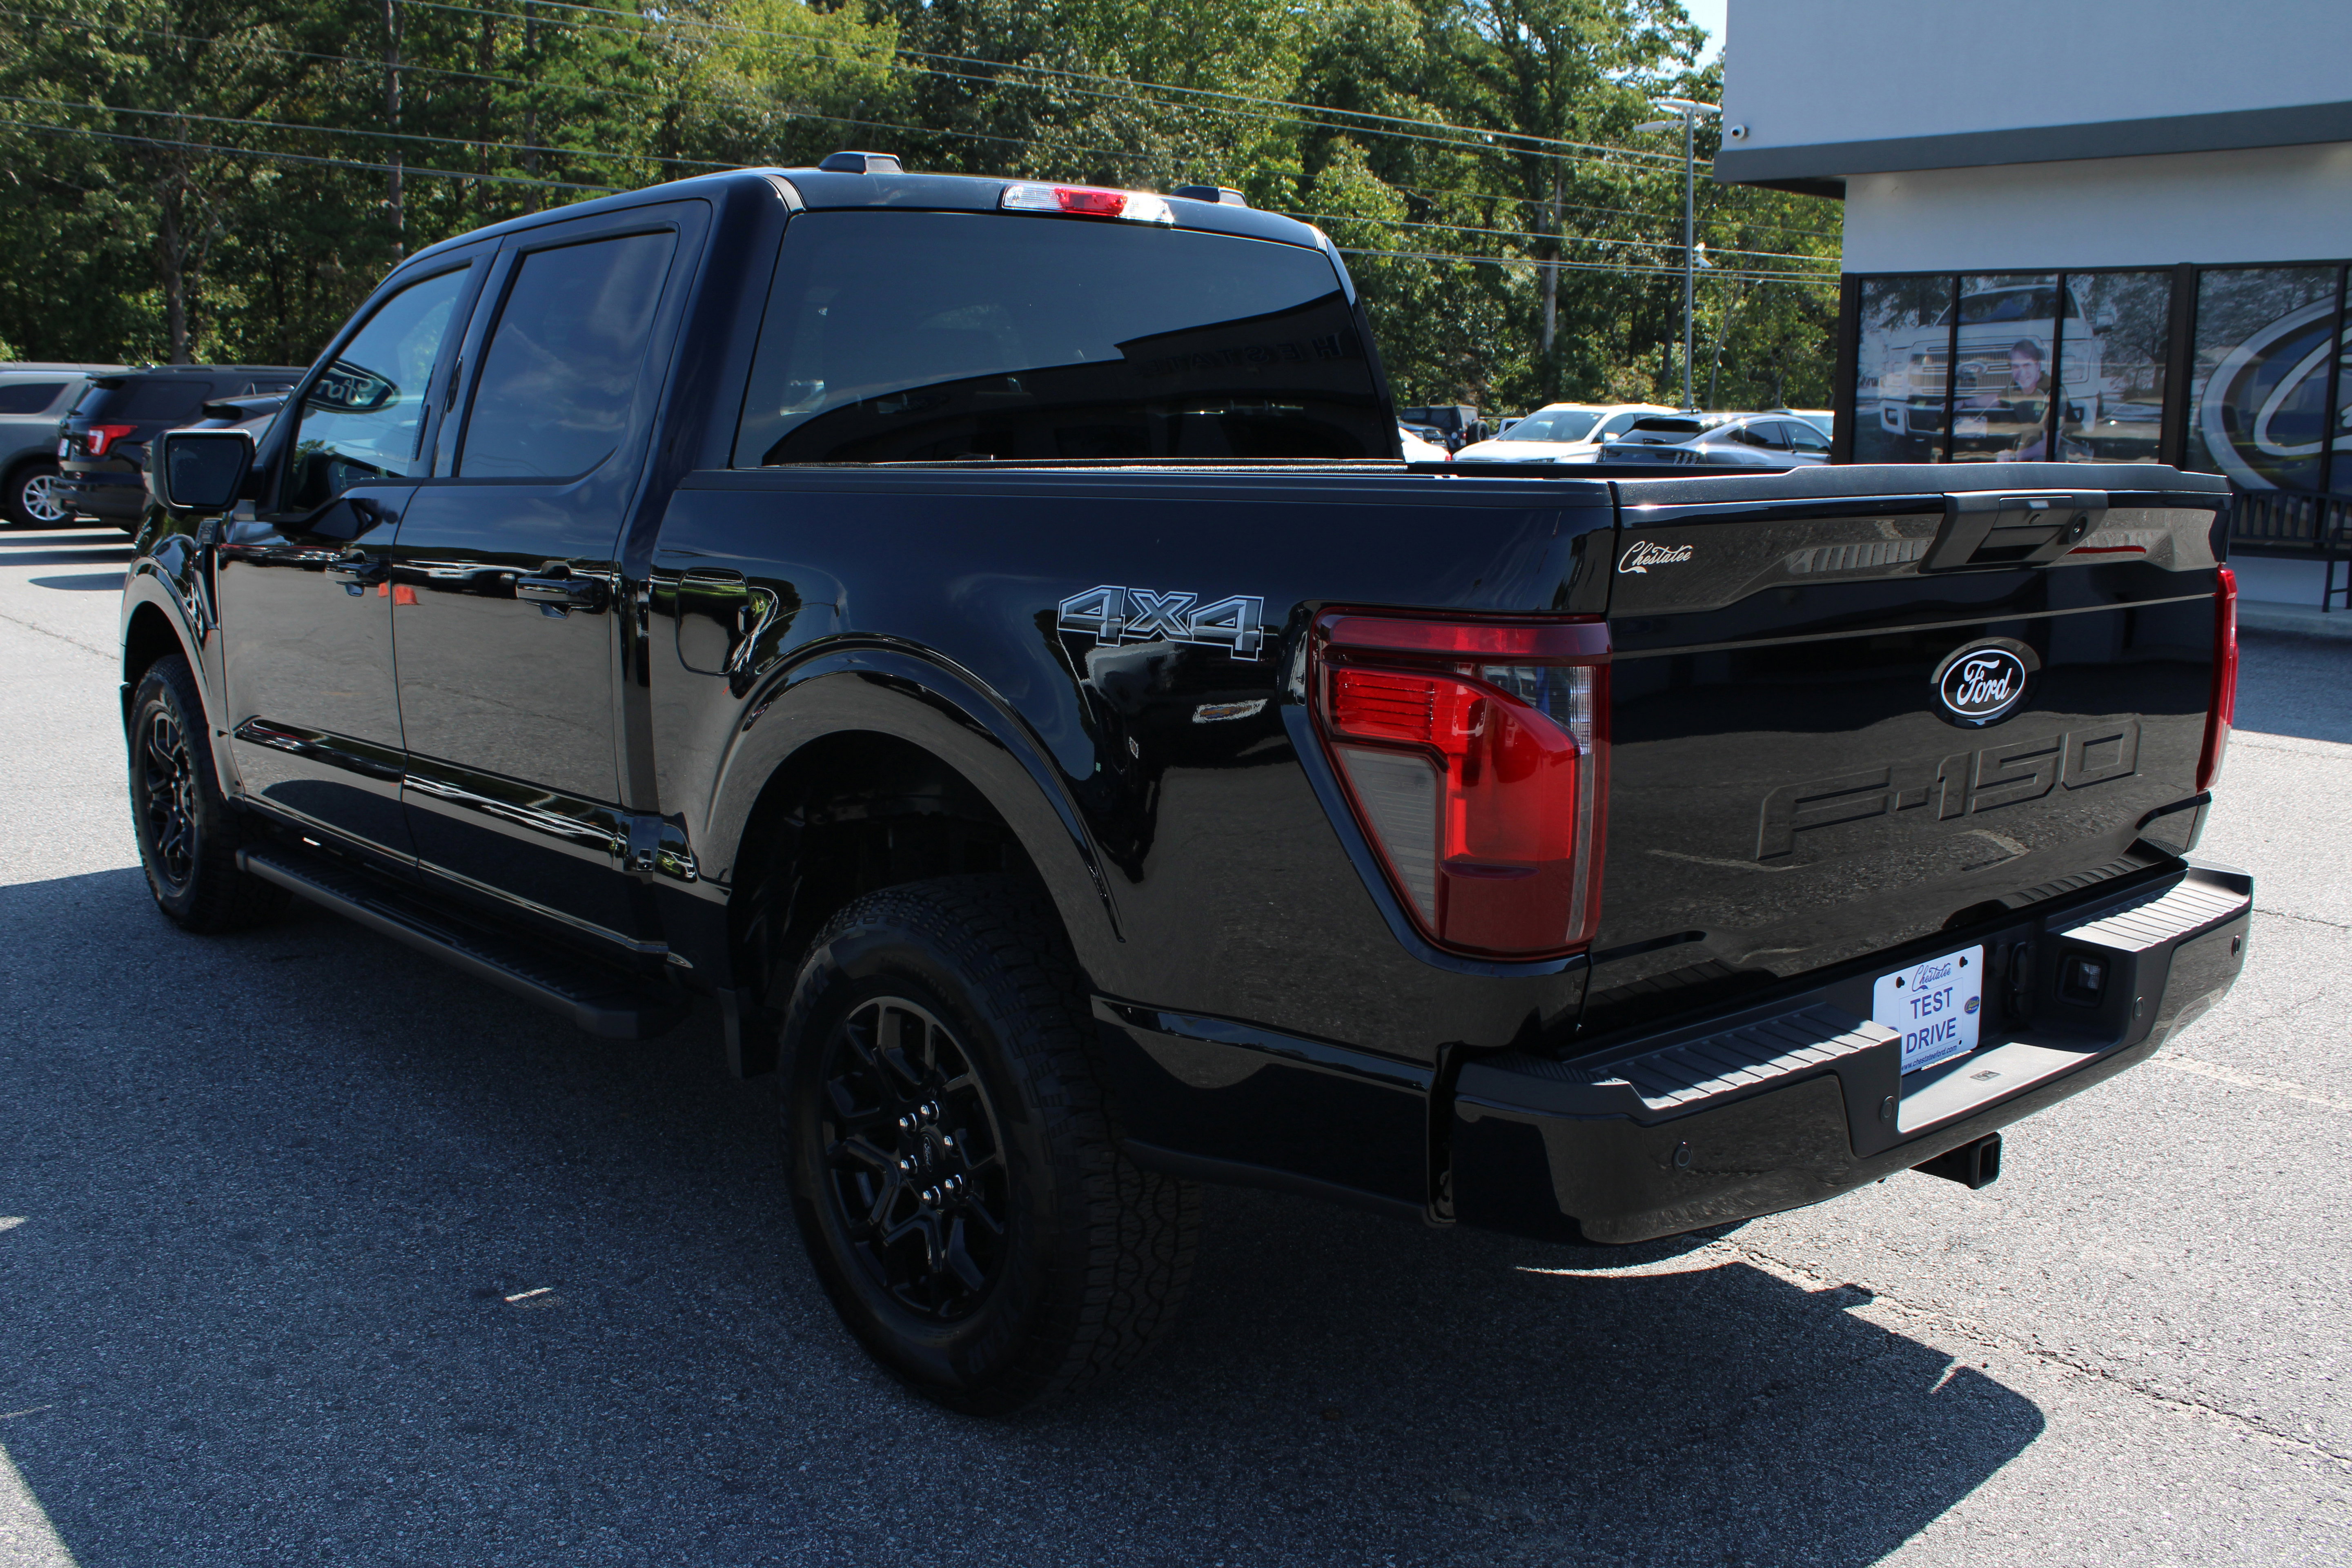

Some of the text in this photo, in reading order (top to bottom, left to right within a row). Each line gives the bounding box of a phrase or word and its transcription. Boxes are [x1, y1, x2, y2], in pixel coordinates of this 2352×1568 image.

[1618, 540, 1694, 573] Chestatee
[1956, 659, 2012, 706] Ford
[1912, 963, 1951, 992] Chestatee
[1910, 987, 1953, 1019] TEST
[1906, 1017, 1956, 1054] DRIVE
[924, 1143, 932, 1166] Ford
